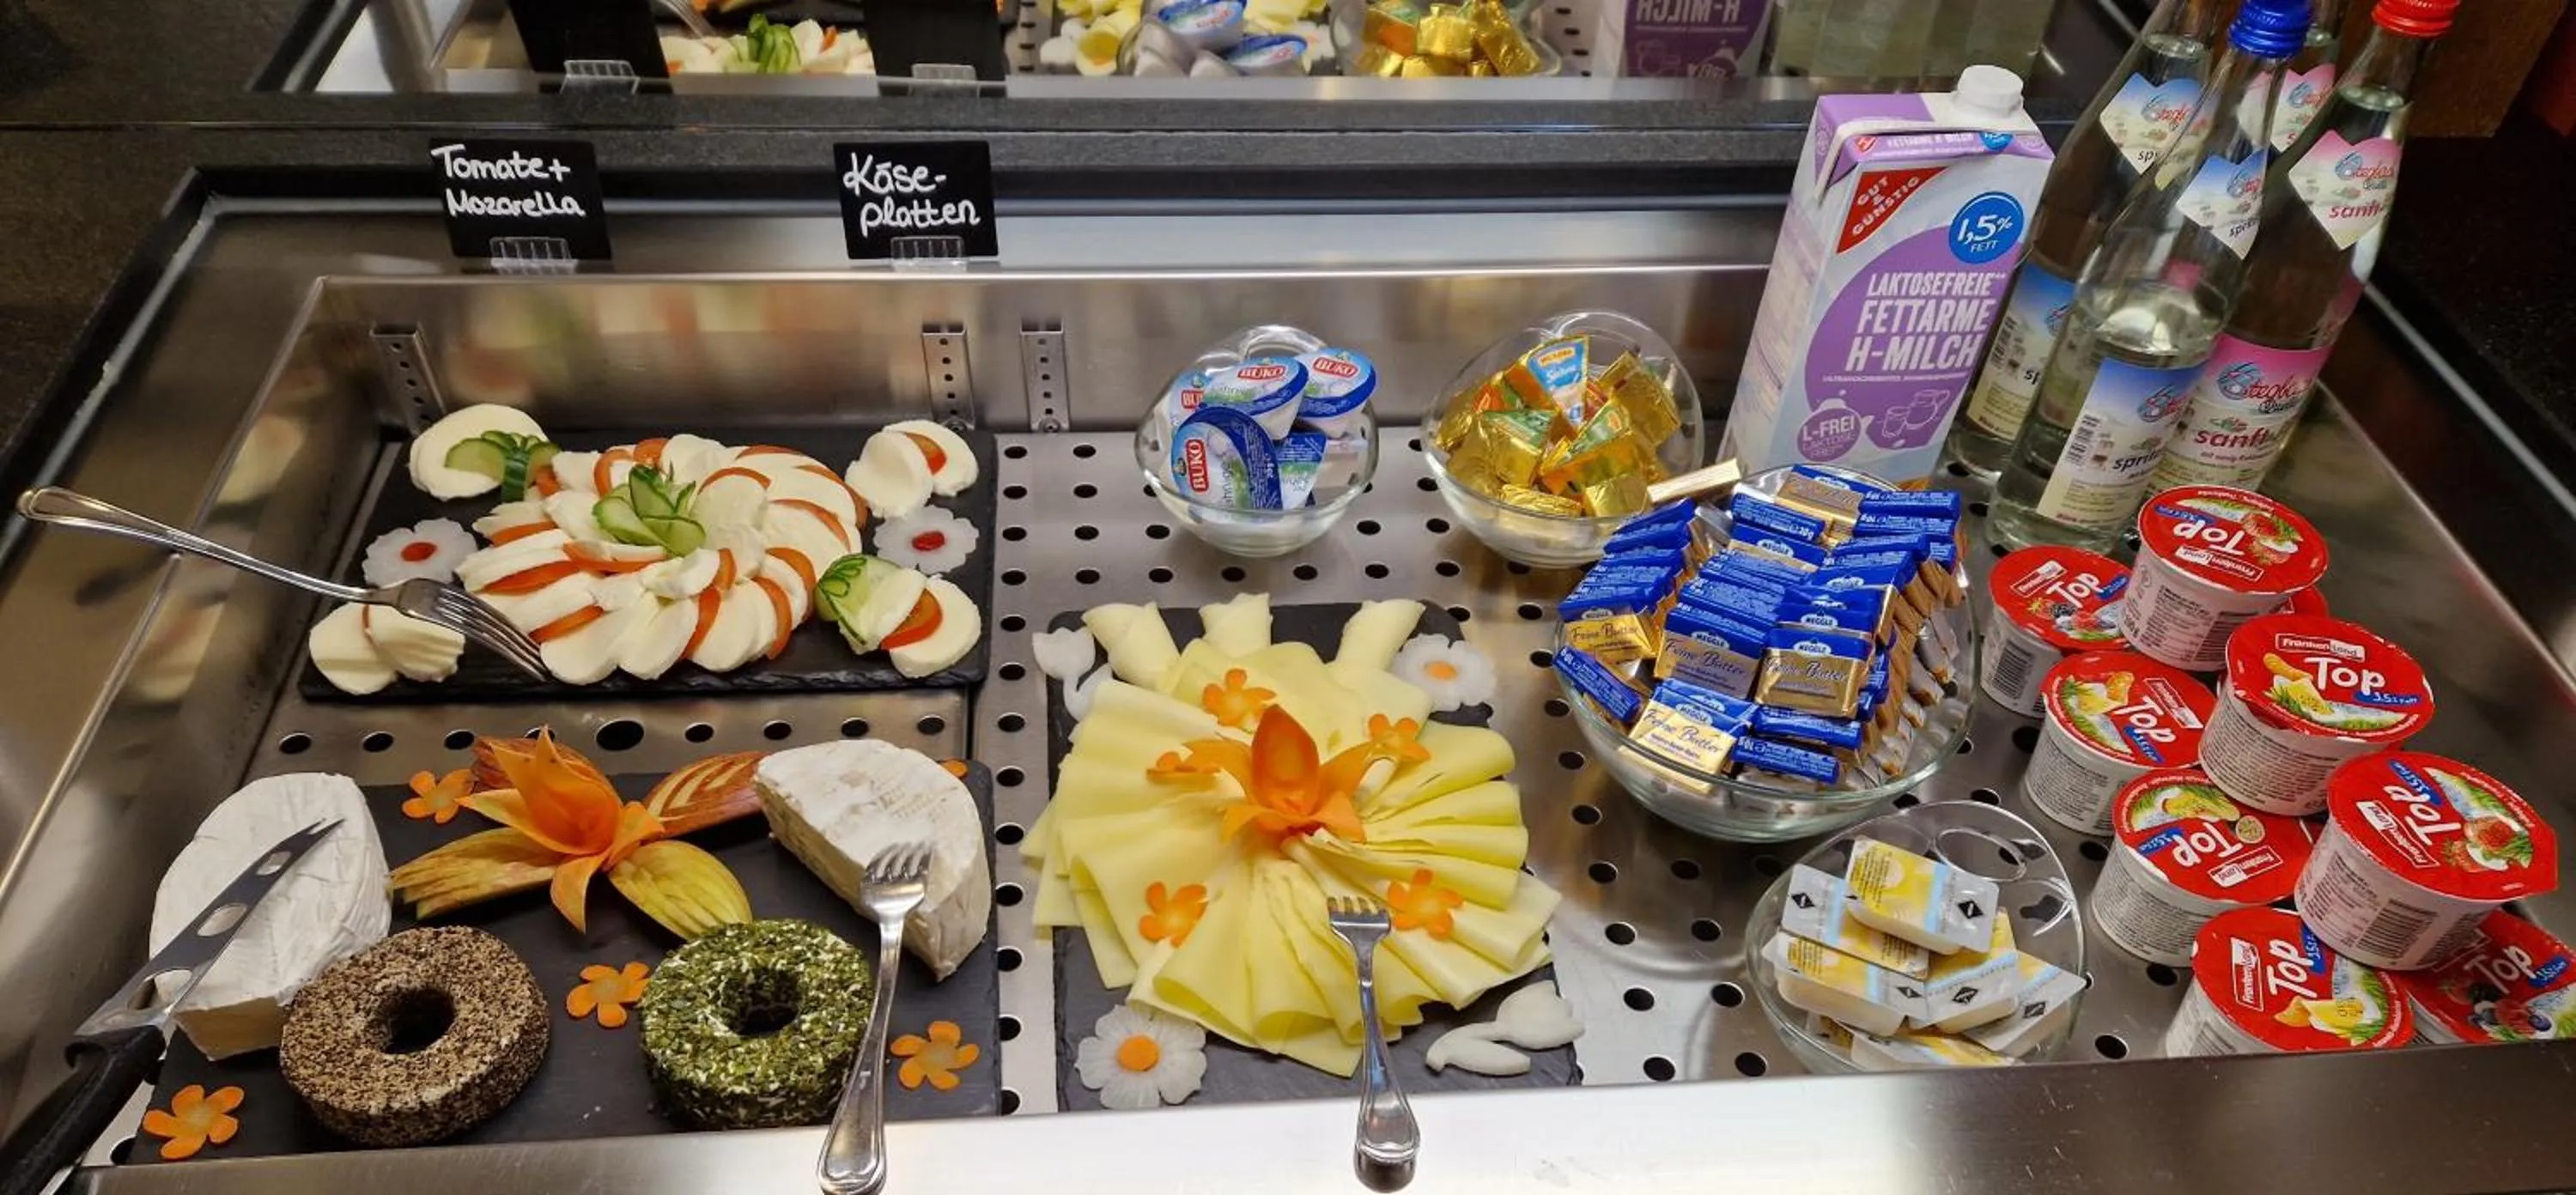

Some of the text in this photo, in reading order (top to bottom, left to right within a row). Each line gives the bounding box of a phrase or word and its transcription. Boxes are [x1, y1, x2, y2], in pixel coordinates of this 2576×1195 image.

[446, 188, 586, 217] Mozarella
[1856, 176, 1889, 206] GUT
[1873, 193, 1886, 206] &
[860, 196, 981, 239] platten
[1957, 214, 2014, 244] 1,5%
[1970, 240, 1998, 253] FETT
[1860, 298, 1996, 334] FETTARME
[1315, 357, 1357, 377] BUKO
[1845, 334, 1984, 372] H-MILCH
[1239, 366, 1285, 380] BUKO
[1183, 391, 1205, 408] BU
[1803, 415, 1855, 442] L-FREI
[1188, 440, 1206, 493] BUKO
[2173, 519, 2245, 555] Top
[2045, 573, 2105, 608] Top
[1696, 634, 1725, 647] MEGGLE
[2304, 657, 2385, 695] Top
[2112, 695, 2177, 743] Top
[2384, 786, 2461, 846] Top
[2172, 822, 2244, 867] Top
[2266, 939, 2318, 998] Top
[2464, 945, 2537, 995] Top
